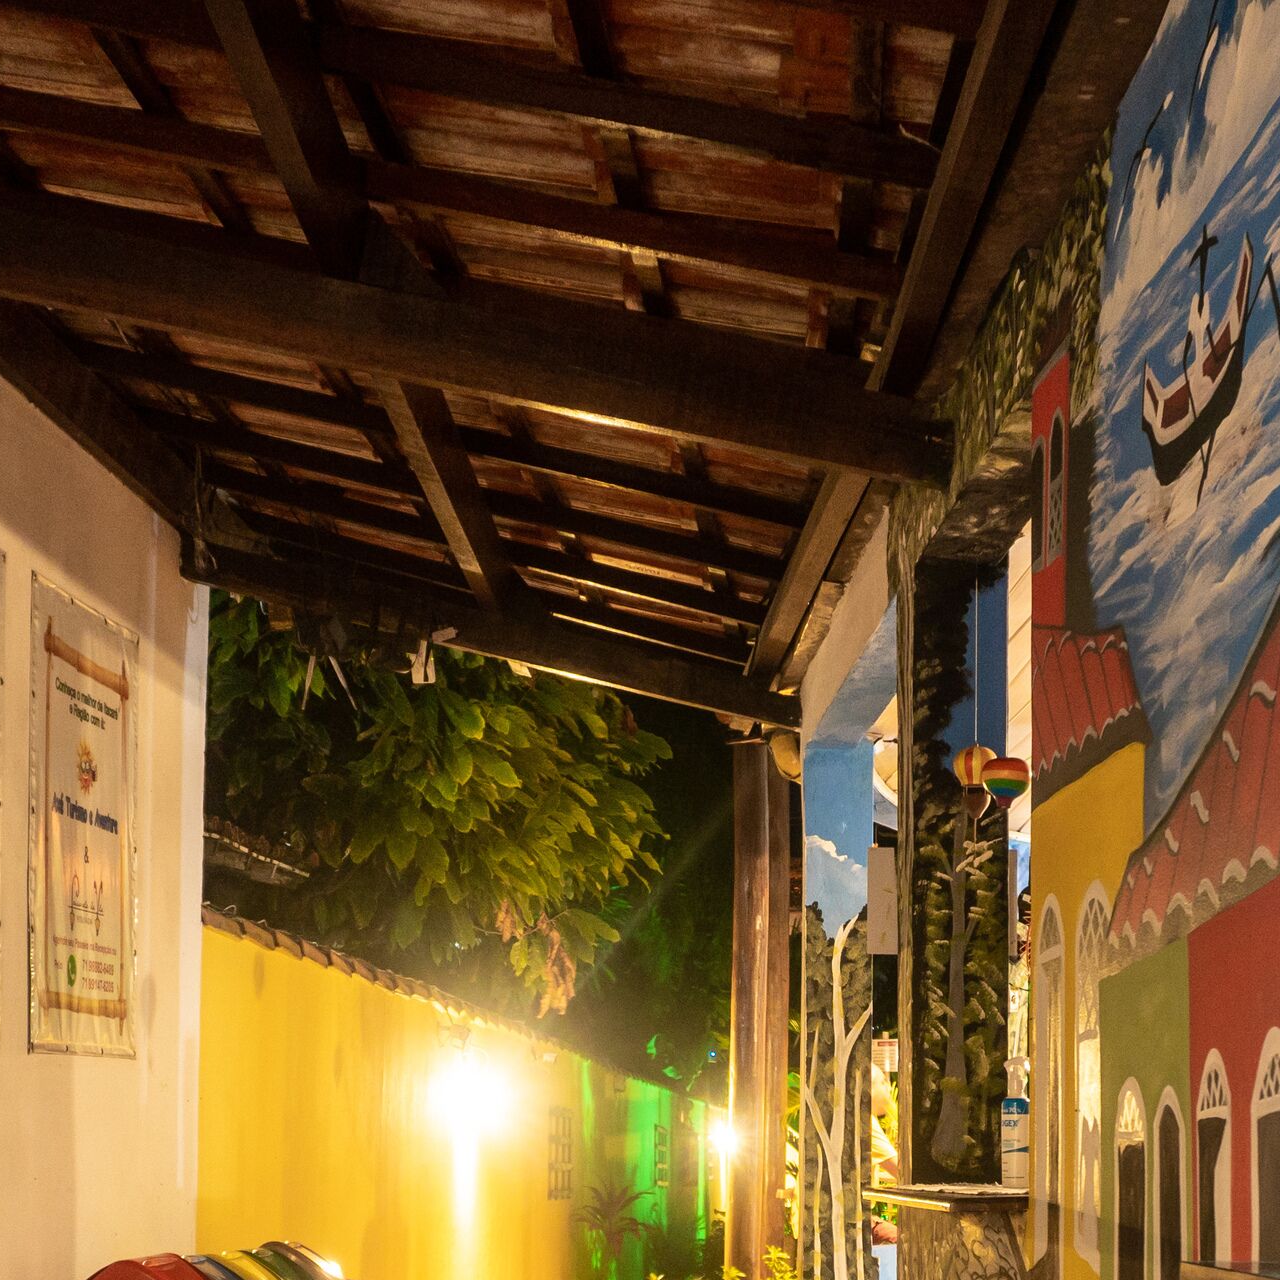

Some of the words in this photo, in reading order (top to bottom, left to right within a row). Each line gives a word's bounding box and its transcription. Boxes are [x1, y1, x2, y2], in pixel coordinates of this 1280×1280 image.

[65, 795, 87, 823] Turismo
[89, 810, 93, 826] e
[94, 808, 118, 835] Aventura
[84, 846, 89, 863] &
